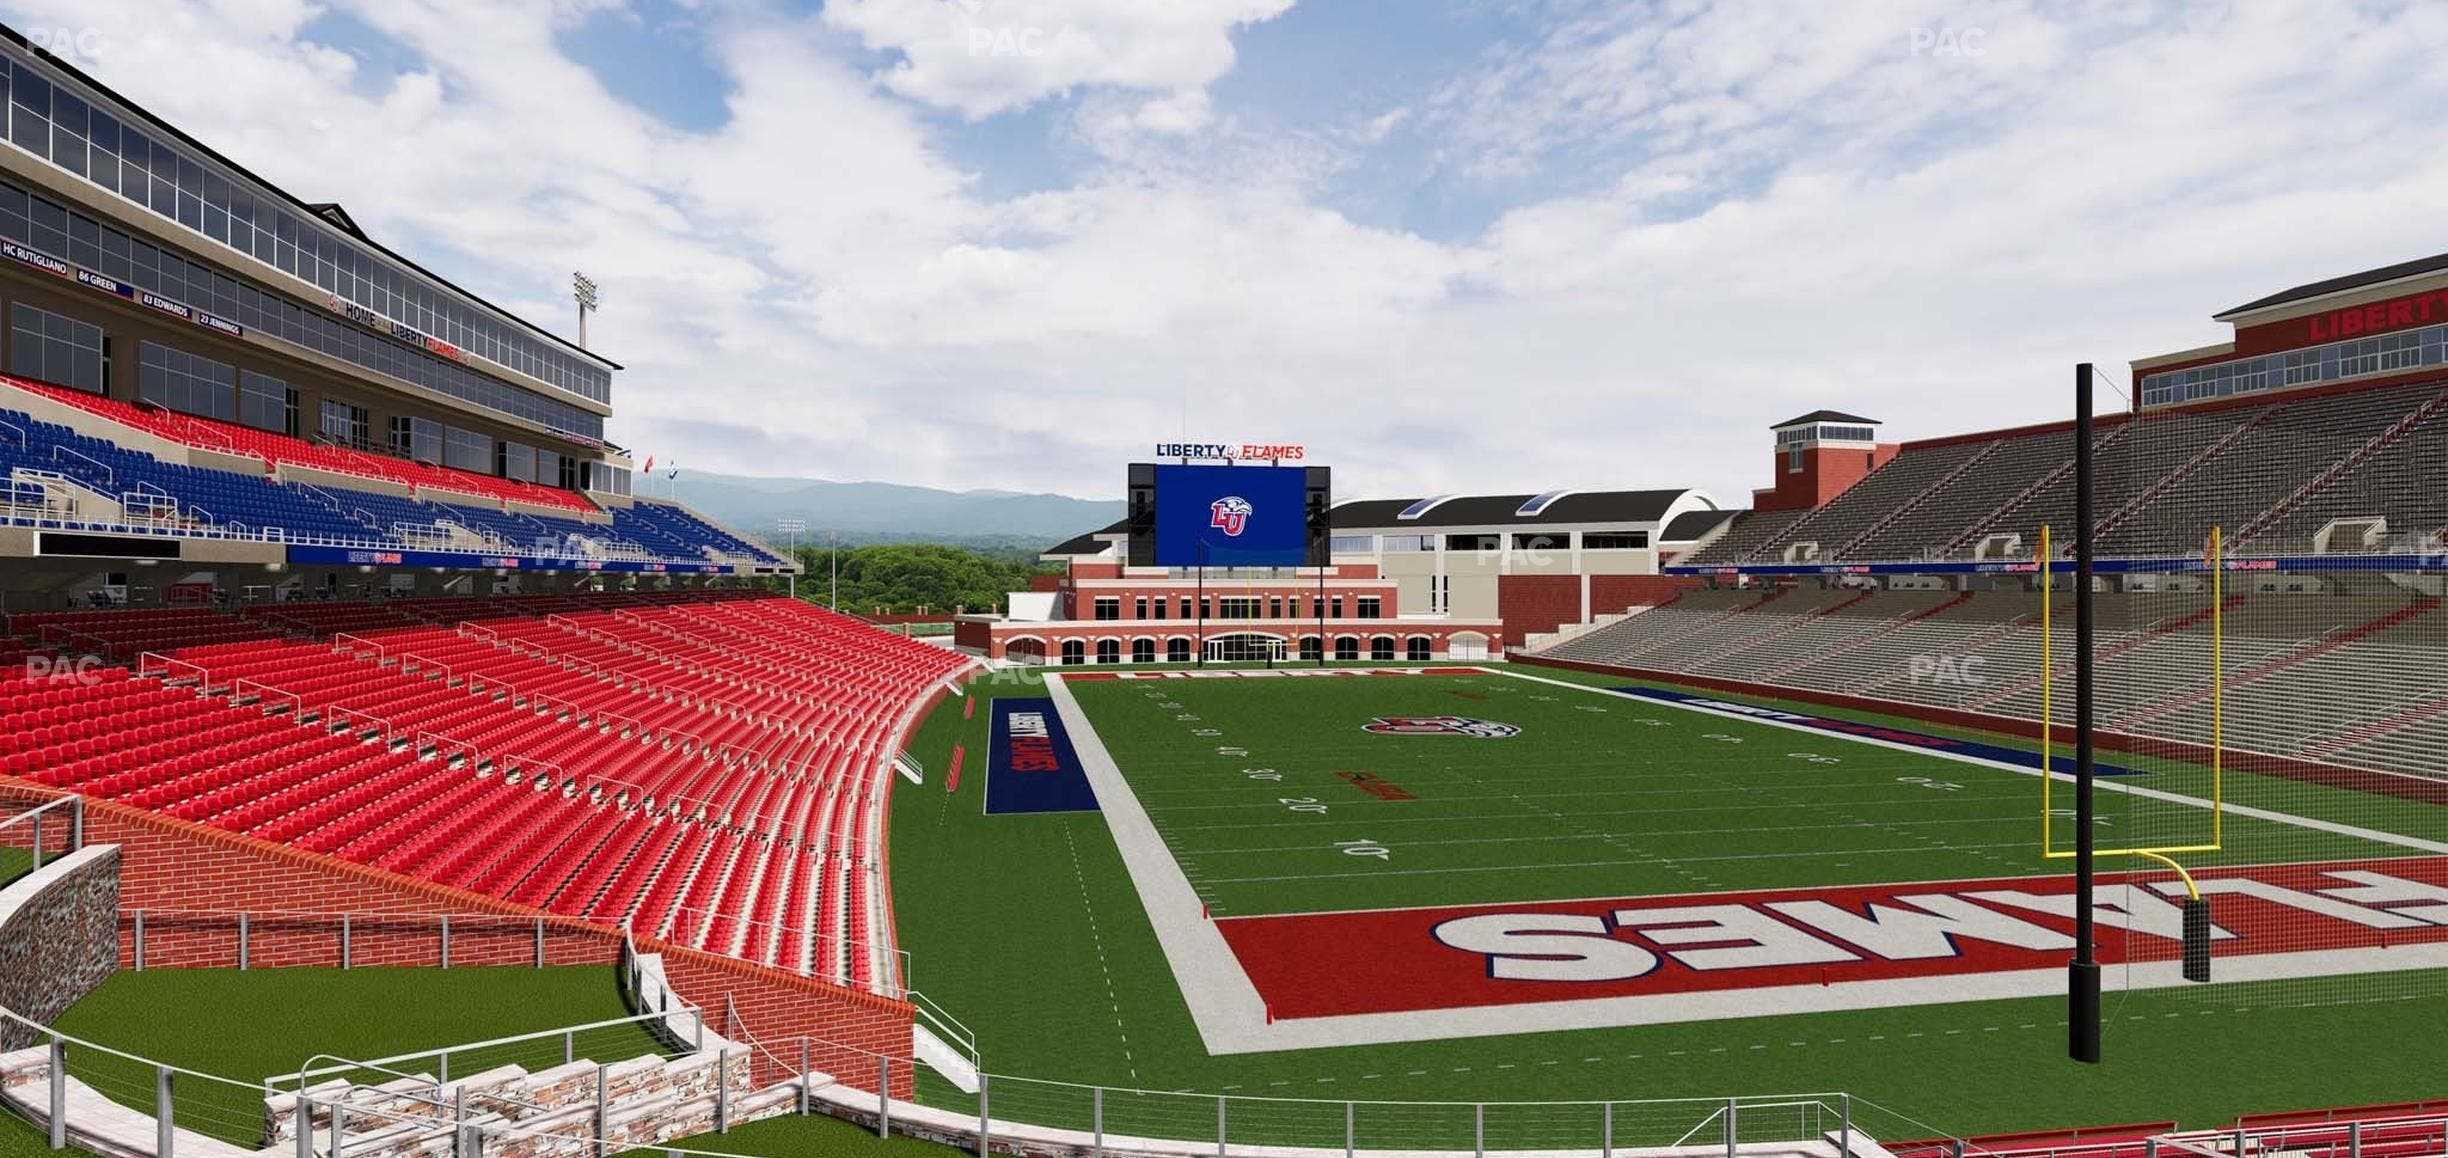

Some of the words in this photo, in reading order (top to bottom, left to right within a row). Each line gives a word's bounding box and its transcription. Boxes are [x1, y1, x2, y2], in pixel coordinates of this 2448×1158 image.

[3, 243, 16, 256] HC
[17, 247, 67, 275] RUTIGLIANO
[78, 270, 89, 282] 86
[90, 274, 117, 293] GREEN
[143, 294, 153, 304] 83
[153, 296, 188, 317] EDWARDS
[346, 302, 376, 327] HOME
[2309, 290, 2448, 341] LIBERT
[200, 314, 209, 324] 23
[209, 317, 240, 334] JENNINGS
[1156, 443, 1226, 458] LIBERTY
[1241, 445, 1304, 460] FLAMES
[1278, 797, 1329, 813] 20
[1333, 838, 1391, 857] 10
